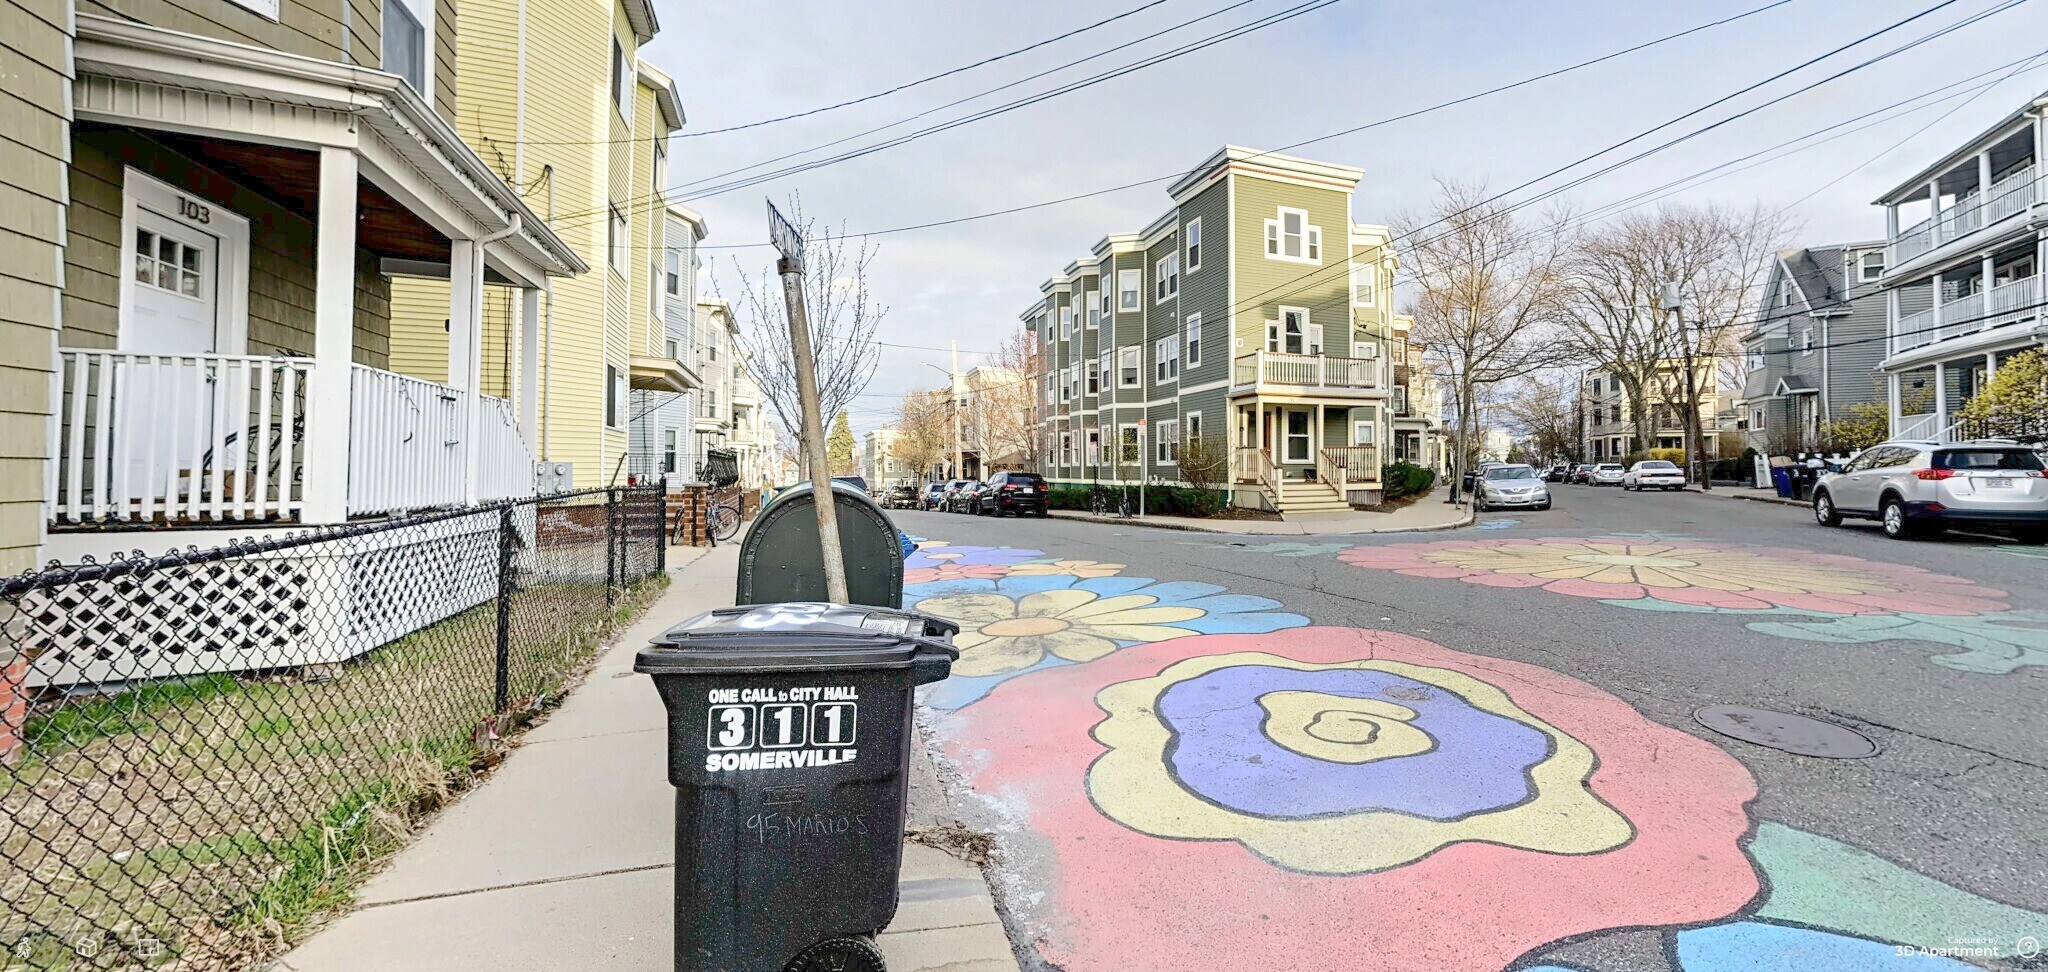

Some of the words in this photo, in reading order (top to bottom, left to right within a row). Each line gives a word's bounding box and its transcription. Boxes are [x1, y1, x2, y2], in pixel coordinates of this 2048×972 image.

[176, 196, 210, 224] 103
[708, 688, 739, 704] ONE
[741, 688, 778, 703] CALL
[778, 690, 789, 702] to
[789, 687, 822, 702] CITY
[823, 686, 859, 701] HALL
[705, 748, 858, 773] SOMERVILLE
[746, 813, 780, 844] 95
